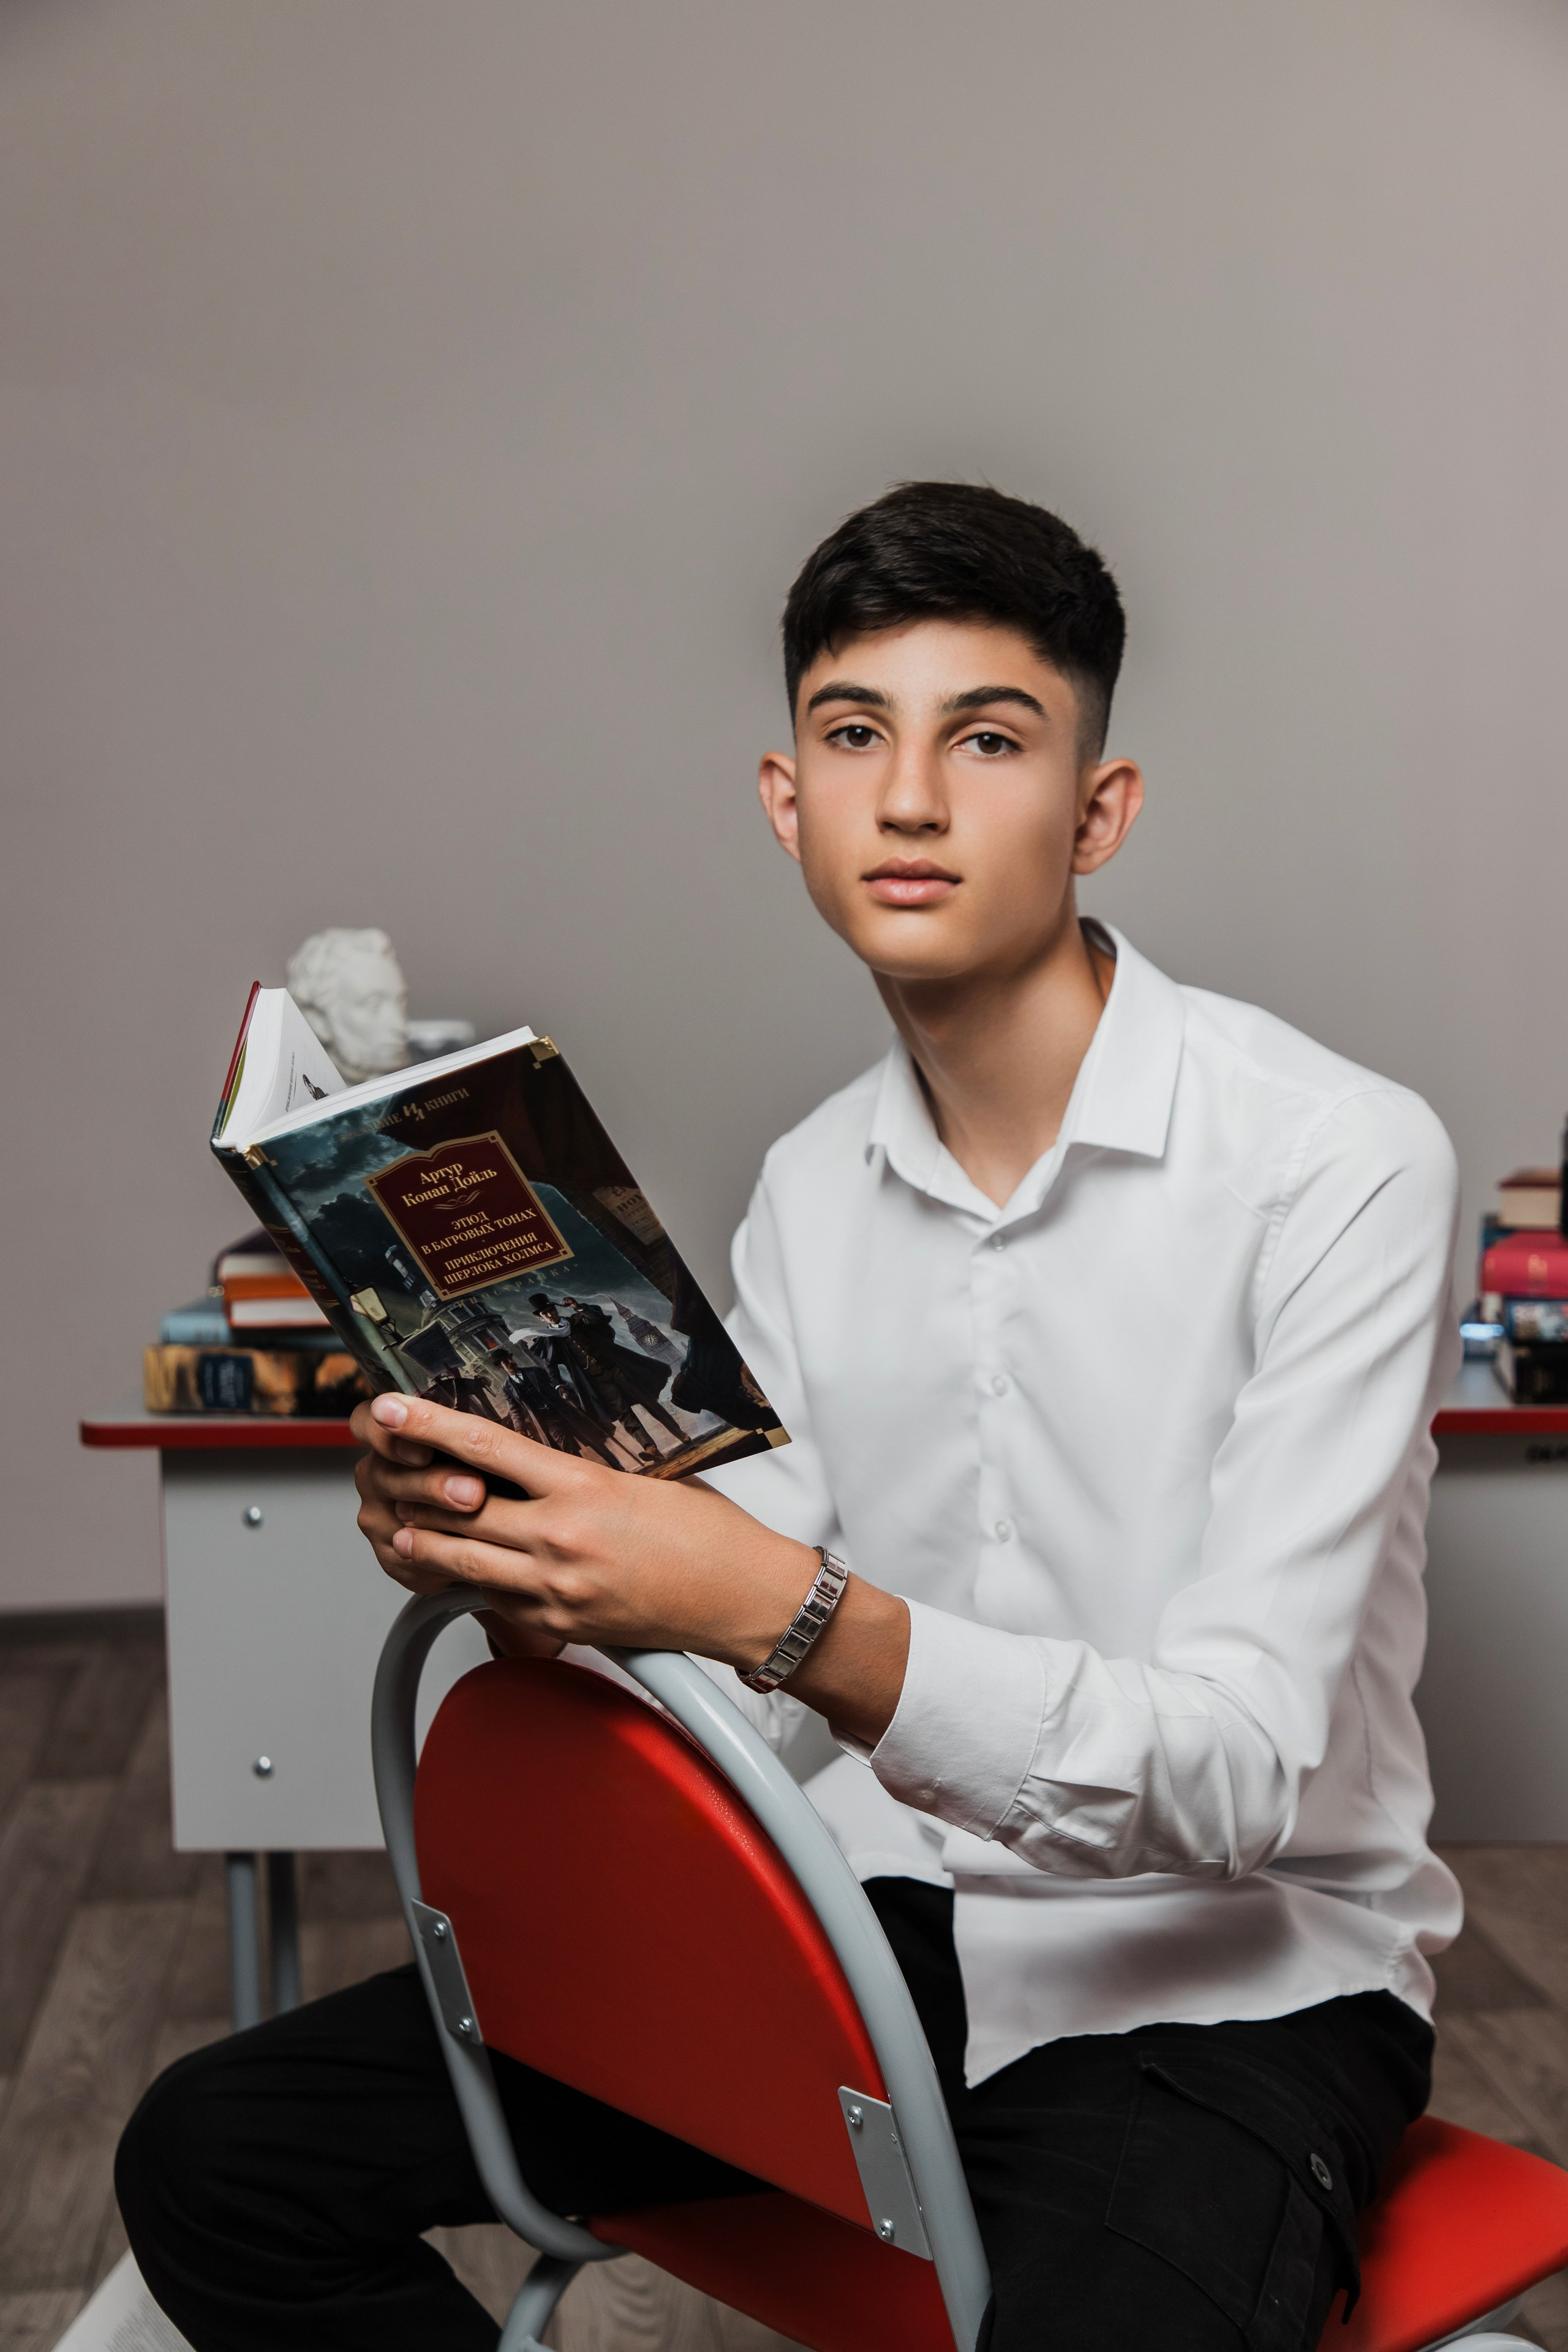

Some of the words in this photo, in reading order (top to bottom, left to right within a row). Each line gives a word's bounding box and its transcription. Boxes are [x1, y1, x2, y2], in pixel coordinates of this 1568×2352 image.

[424, 1088, 470, 1111] КНИГИ
[401, 1185, 450, 1207] Конан
[451, 1169, 497, 1193] Дойль
[420, 1164, 463, 1184] Артур
[421, 1245, 431, 1254] В
[431, 1225, 495, 1251] БАГРОВЫХ
[494, 1208, 537, 1229] ТОНАХ
[451, 1212, 489, 1230] ЭТЮД
[443, 1258, 503, 1284] ШЕРЛОКА
[506, 1242, 553, 1264] ХОЛМСА
[444, 1232, 538, 1271] ПРИКЛЮЧЕНИЯ
